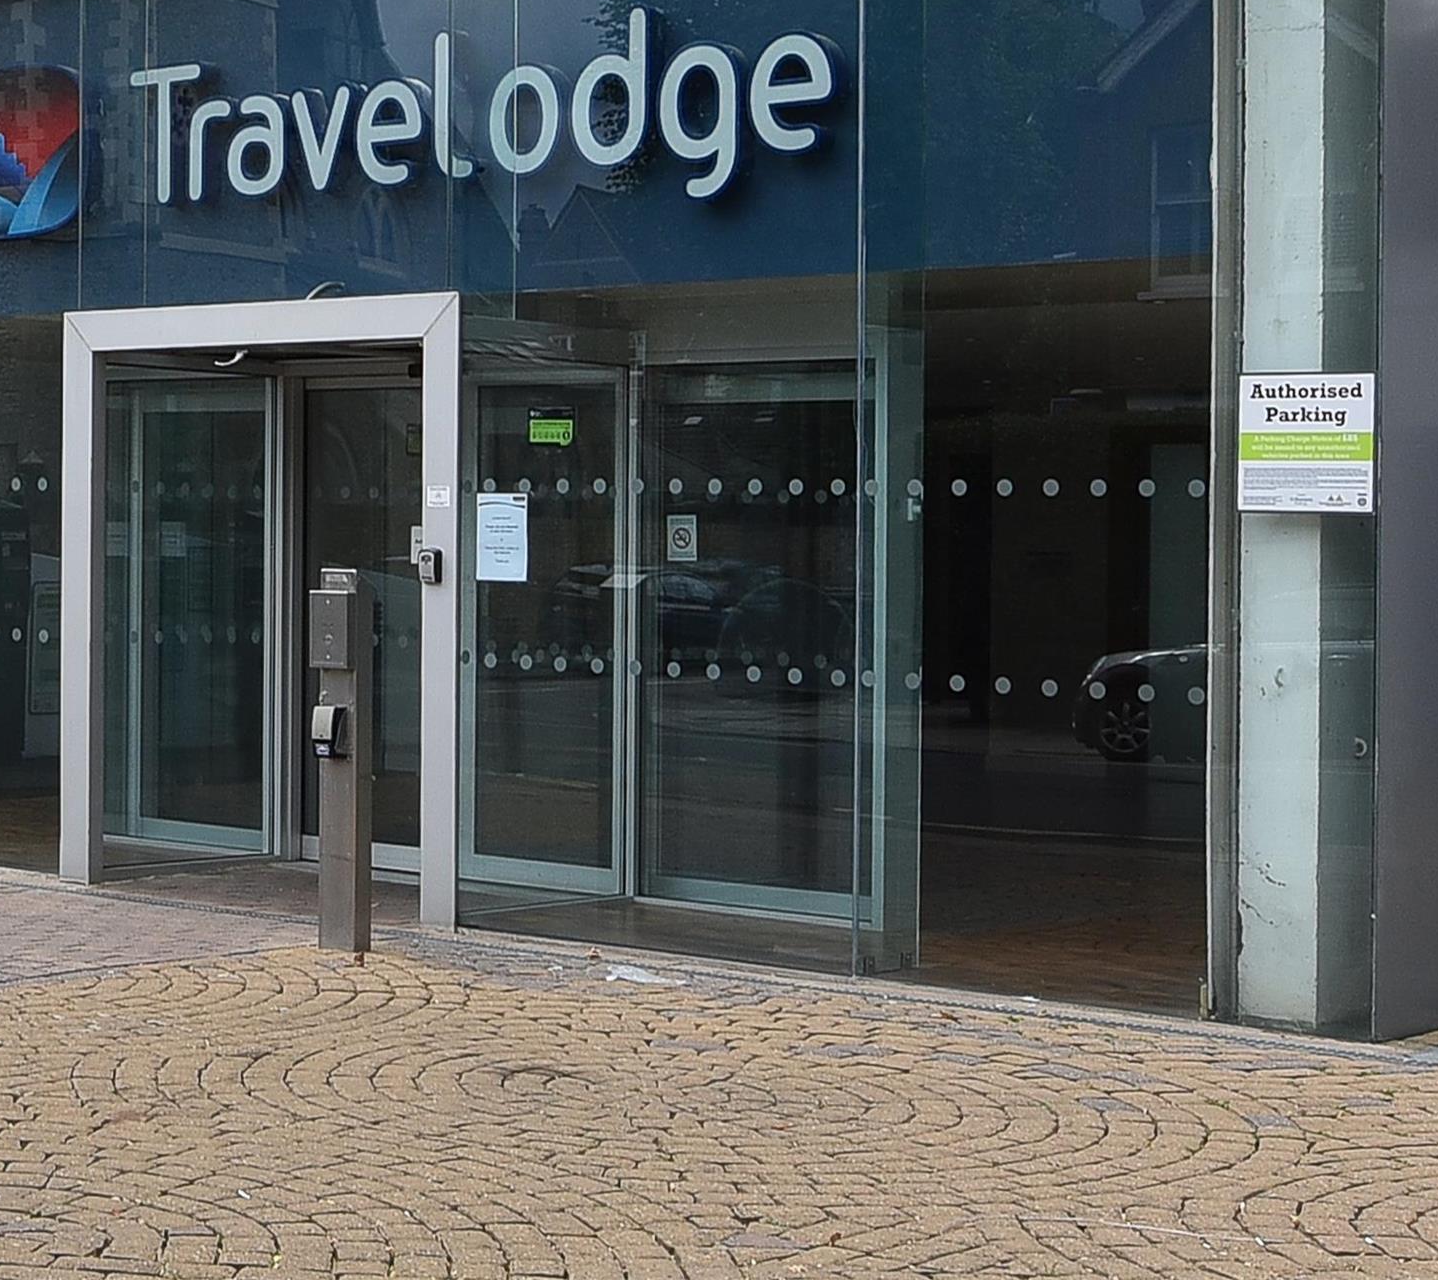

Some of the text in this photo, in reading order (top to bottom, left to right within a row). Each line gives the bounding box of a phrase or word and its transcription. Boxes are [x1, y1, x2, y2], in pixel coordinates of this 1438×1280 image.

[130, 7, 833, 202] Travelodge
[1250, 382, 1363, 399] Authorised
[1265, 406, 1347, 427] Parking
